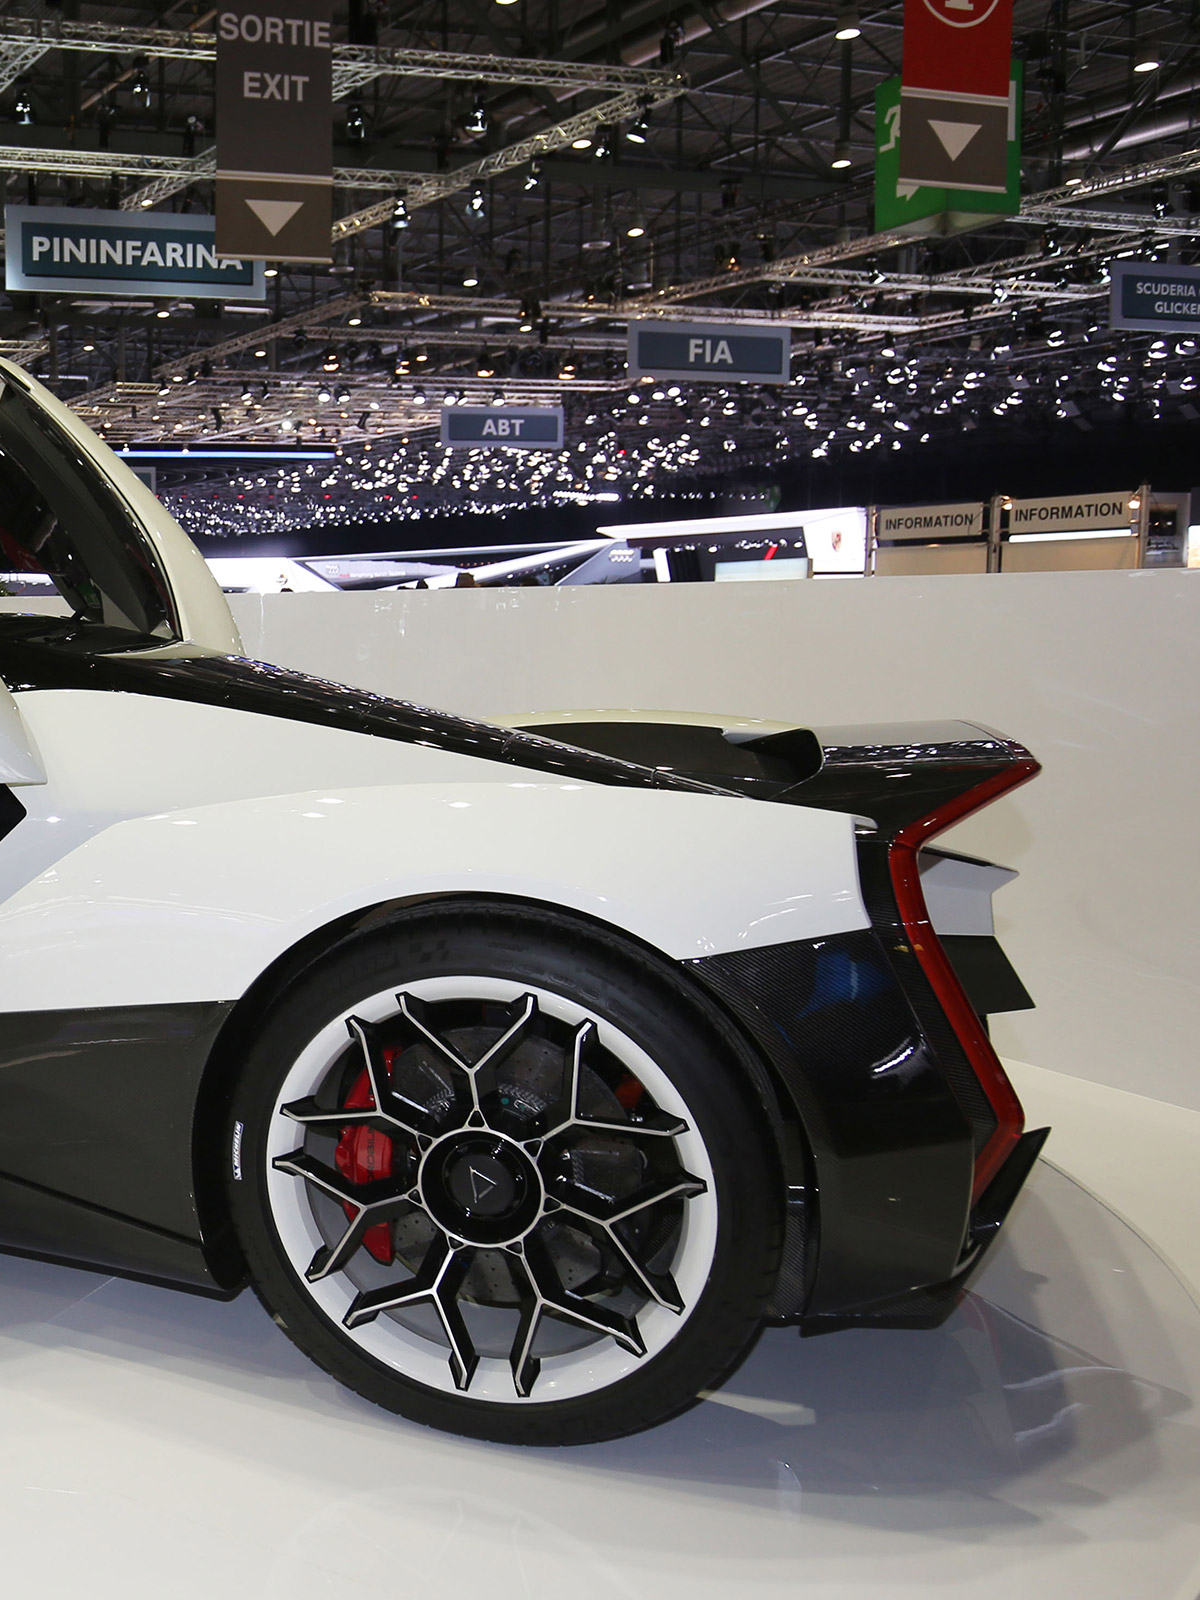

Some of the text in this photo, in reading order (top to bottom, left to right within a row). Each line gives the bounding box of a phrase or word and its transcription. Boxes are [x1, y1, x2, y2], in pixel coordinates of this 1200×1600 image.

[219, 13, 331, 48] SORTIE
[243, 71, 309, 101] EXIT
[1136, 282, 1196, 297] SCUDERIA
[1154, 301, 1200, 315] GLICKE
[688, 339, 734, 365] FIA
[481, 418, 525, 437] ABT
[1014, 501, 1123, 522] INFORMATION
[885, 513, 974, 531] INFORMATION
